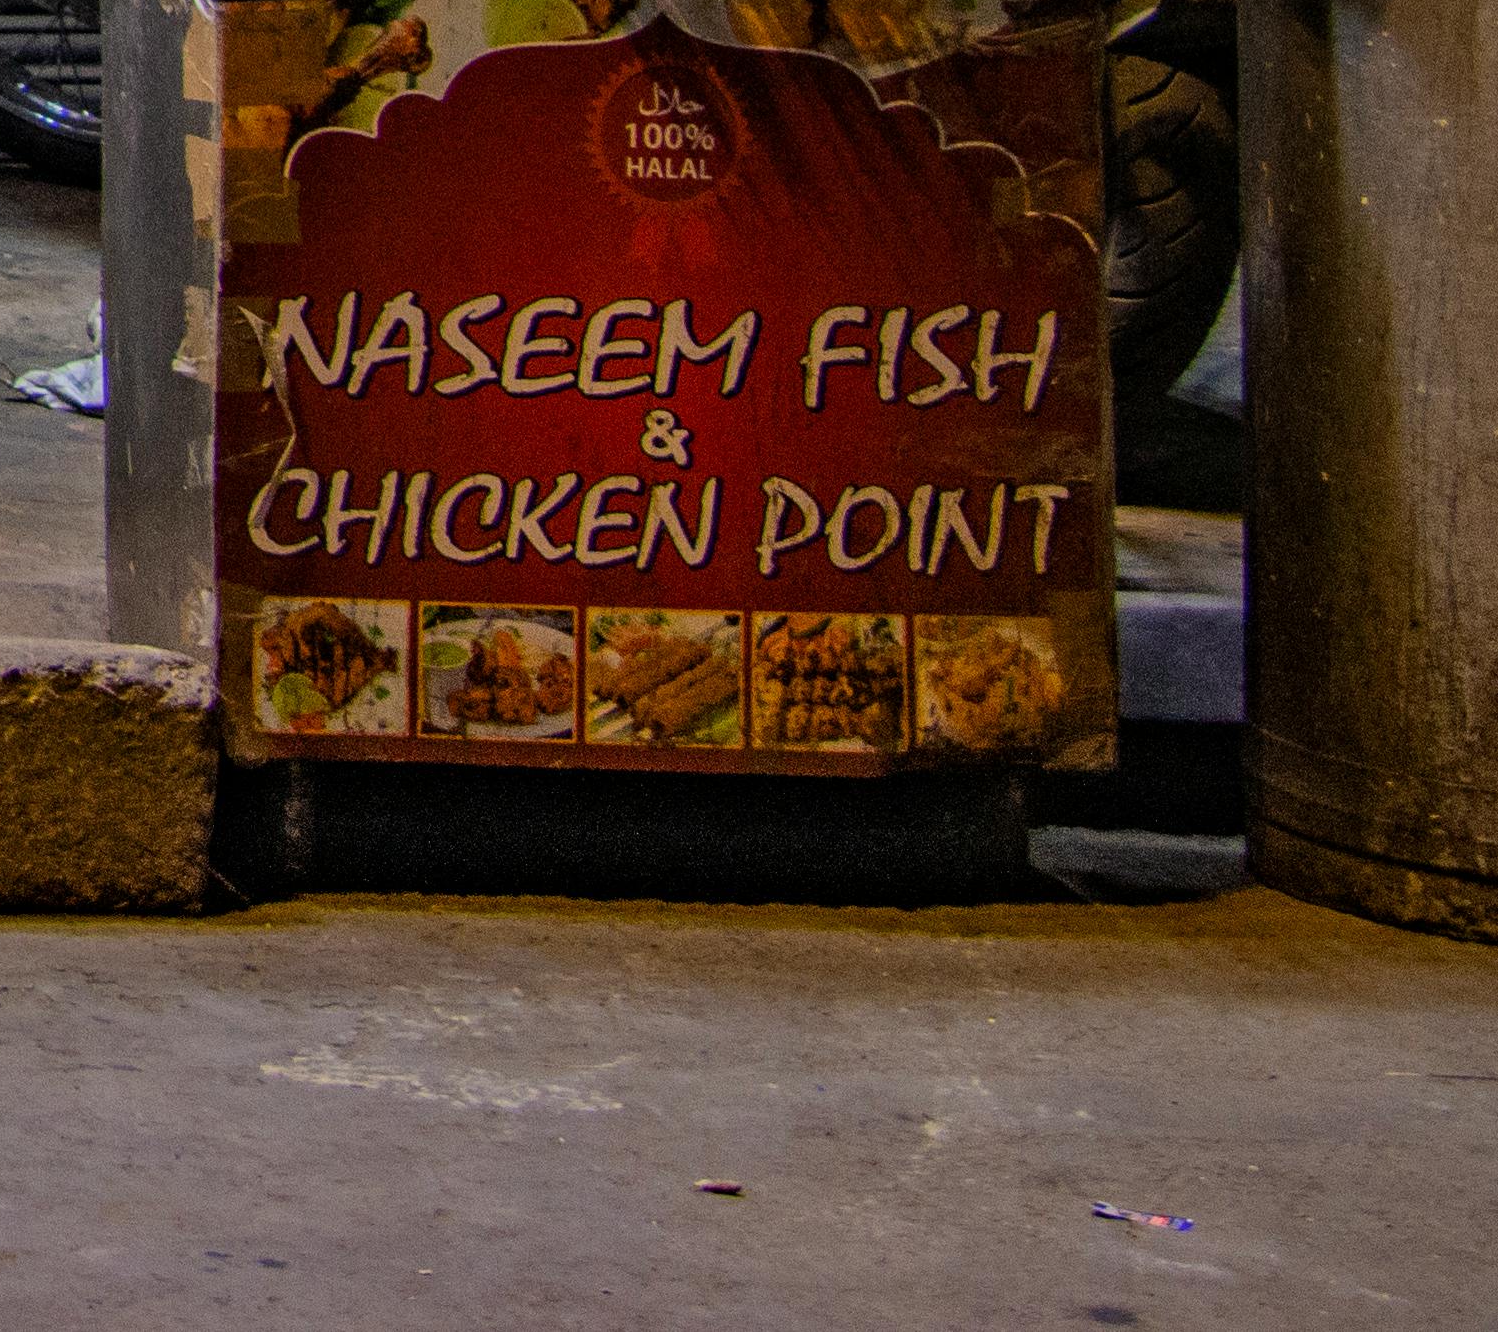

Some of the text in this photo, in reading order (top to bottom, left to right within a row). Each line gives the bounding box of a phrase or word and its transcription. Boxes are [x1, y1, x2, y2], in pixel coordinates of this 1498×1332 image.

[638, 80, 705, 118] حلال
[625, 122, 717, 154] 100%
[626, 155, 714, 182] HALAL
[262, 290, 1060, 413] NASEEM FISH
[641, 410, 692, 466] &
[247, 467, 1071, 577] CHICKEN POINT
